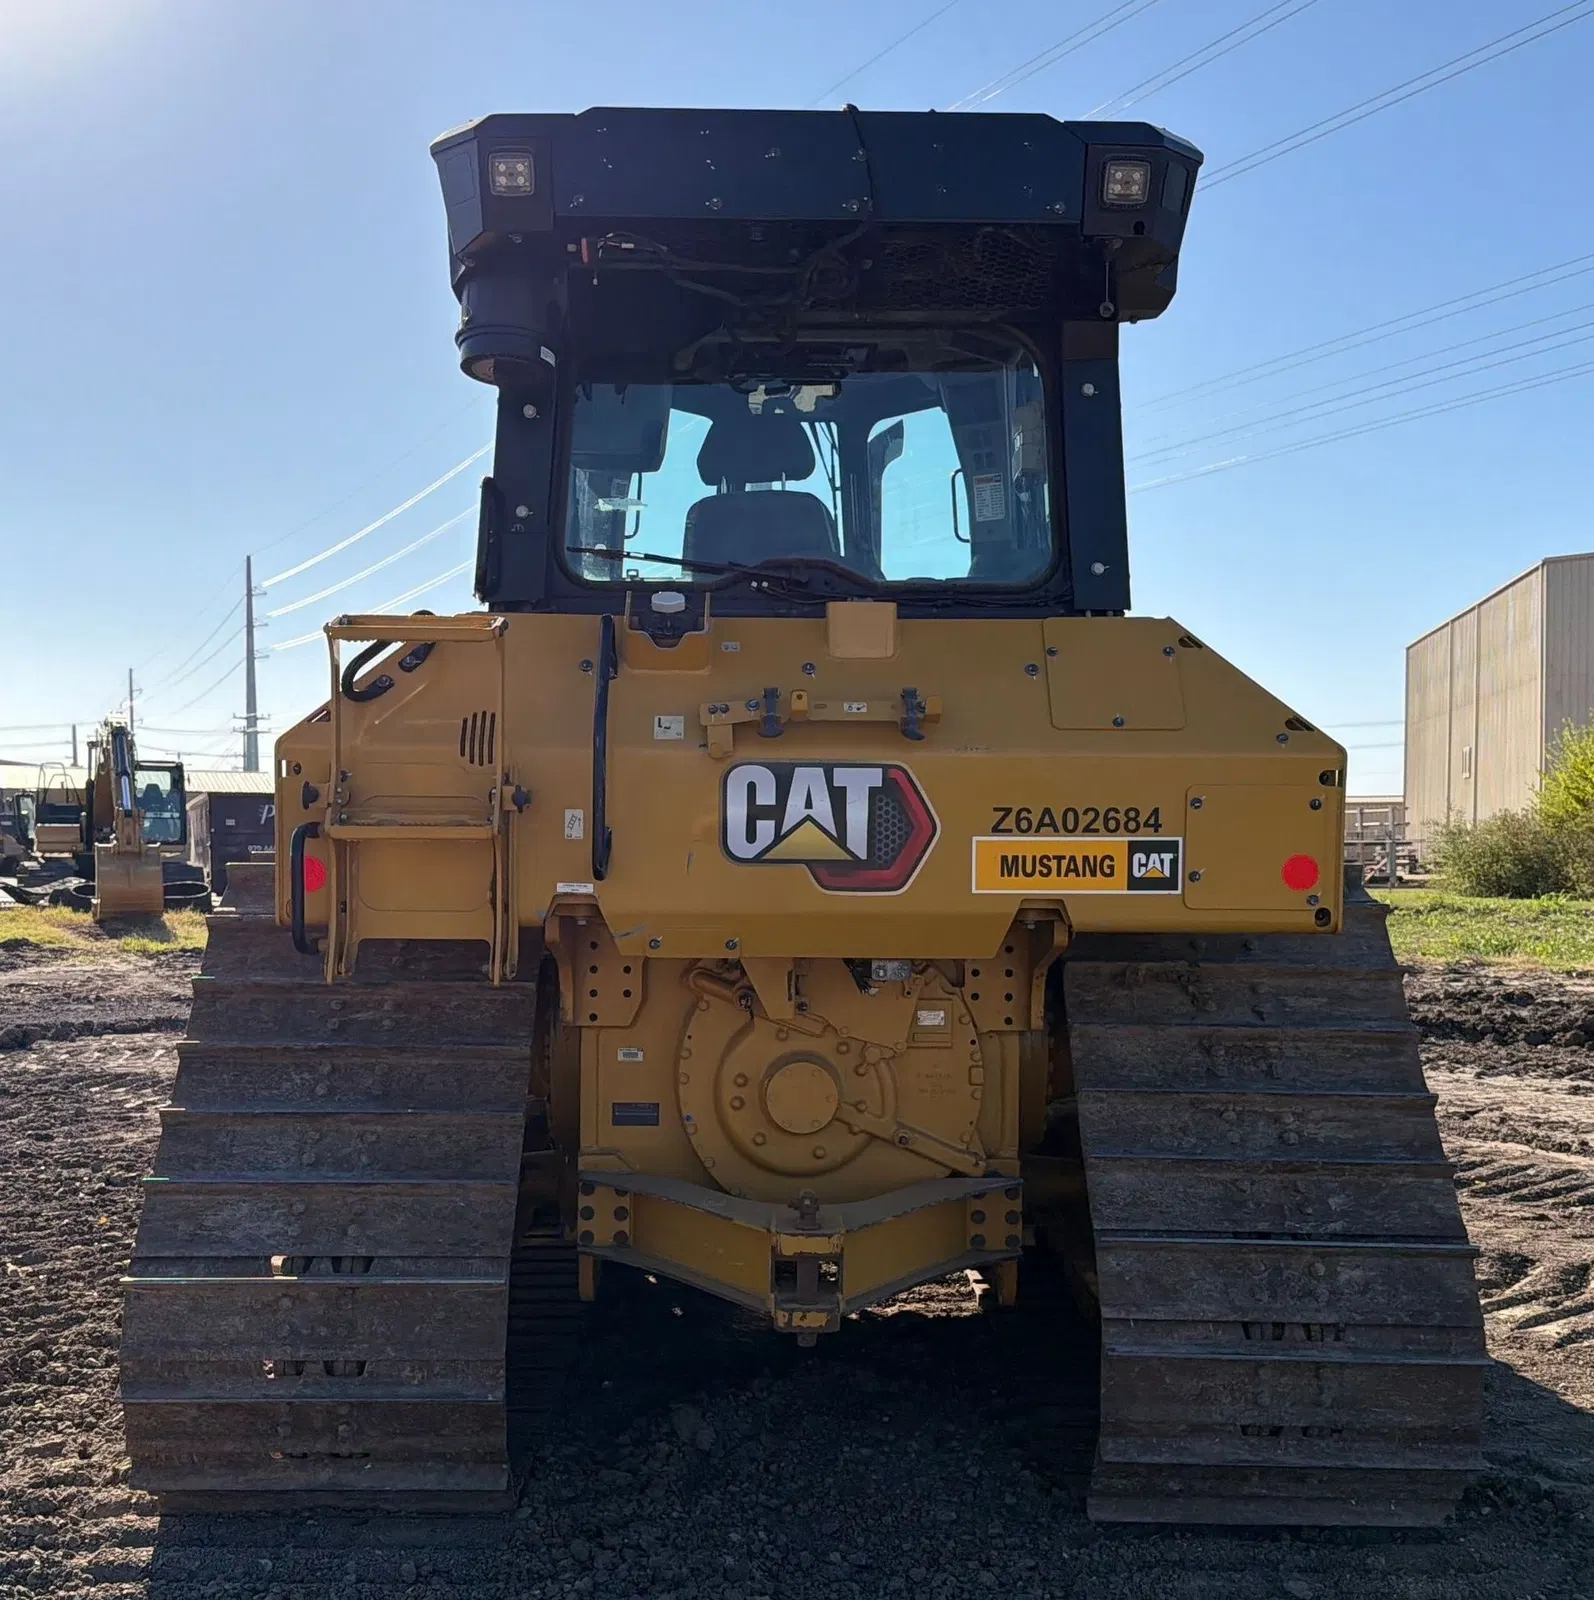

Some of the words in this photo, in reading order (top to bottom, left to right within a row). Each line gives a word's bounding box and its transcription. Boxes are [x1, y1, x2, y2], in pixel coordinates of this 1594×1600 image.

[727, 765, 883, 860] CAT
[991, 806, 1163, 834] Z6A02684
[1000, 854, 1115, 879] MUSTANG
[1133, 853, 1175, 879] CAT
